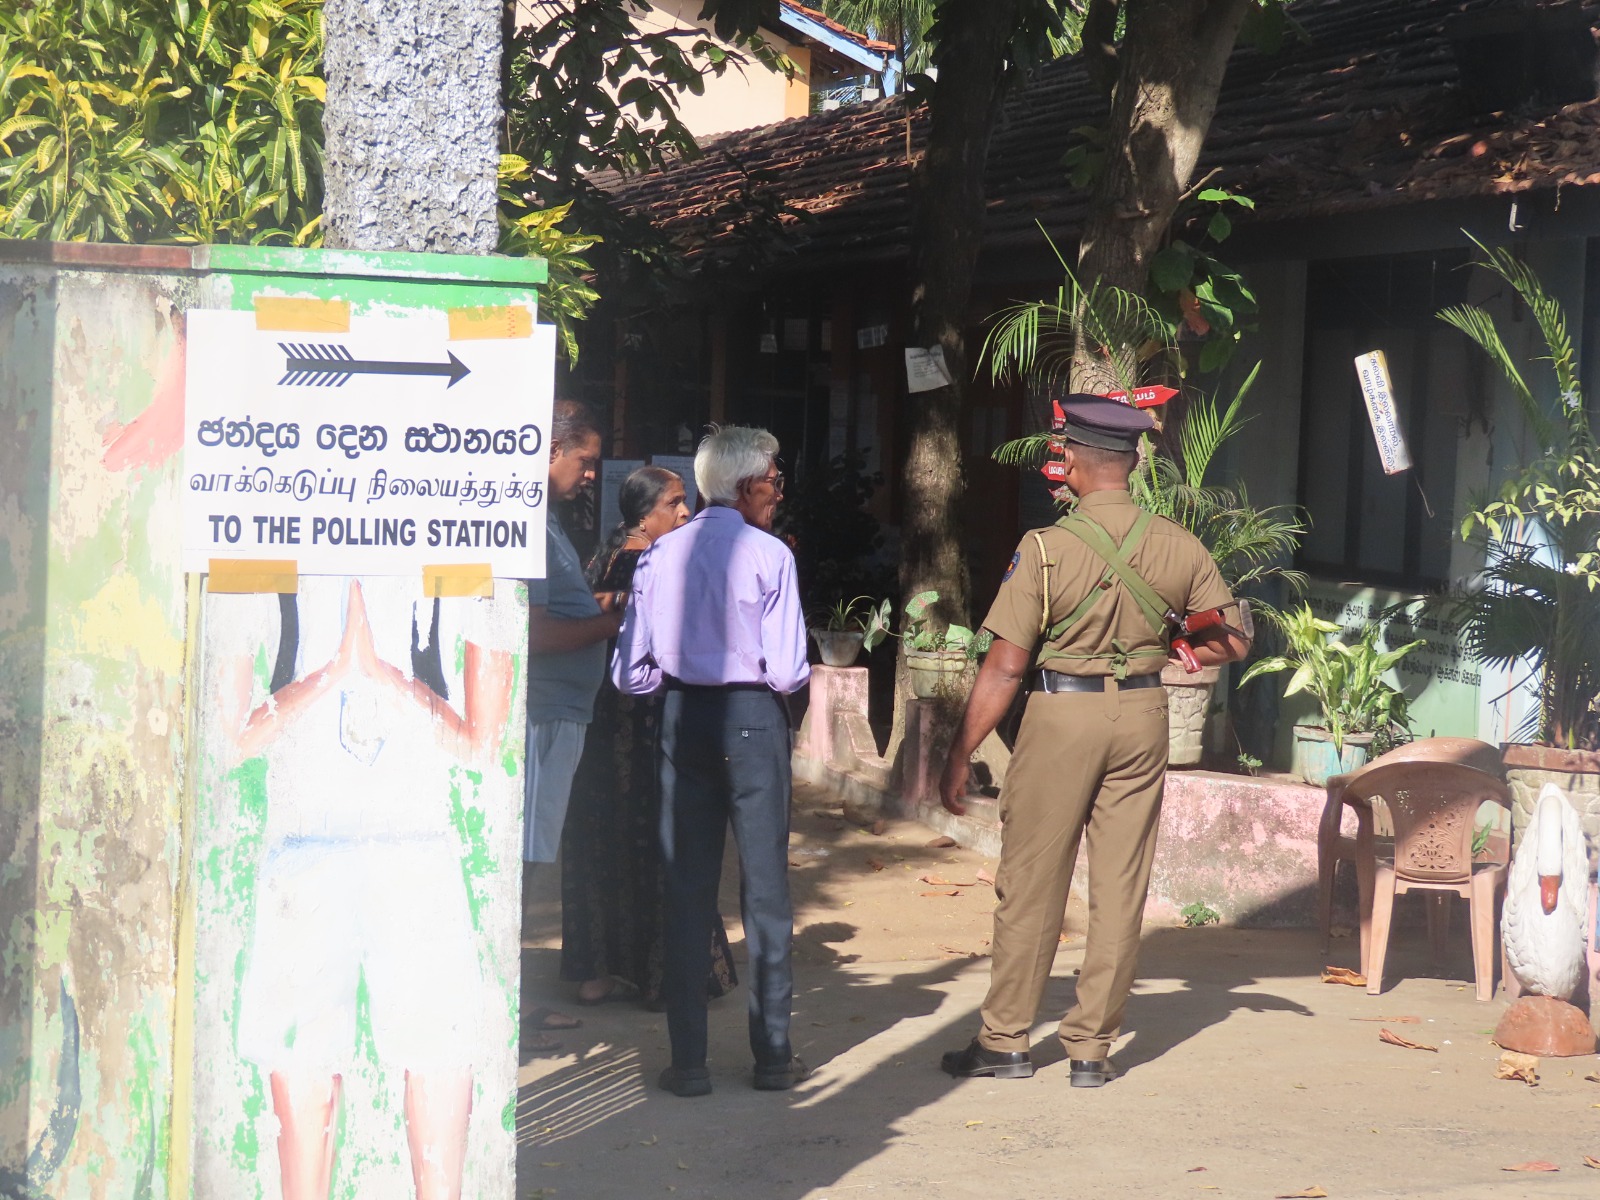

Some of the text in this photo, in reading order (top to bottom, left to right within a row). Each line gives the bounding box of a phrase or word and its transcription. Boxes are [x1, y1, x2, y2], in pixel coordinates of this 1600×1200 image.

[198, 415, 300, 458] ඡන්දය
[316, 423, 388, 460] දෙන
[190, 466, 543, 509] வாக்கெடுப்பு நிலையத்துக்கு
[208, 514, 527, 548] TO THE POLLING STATION
